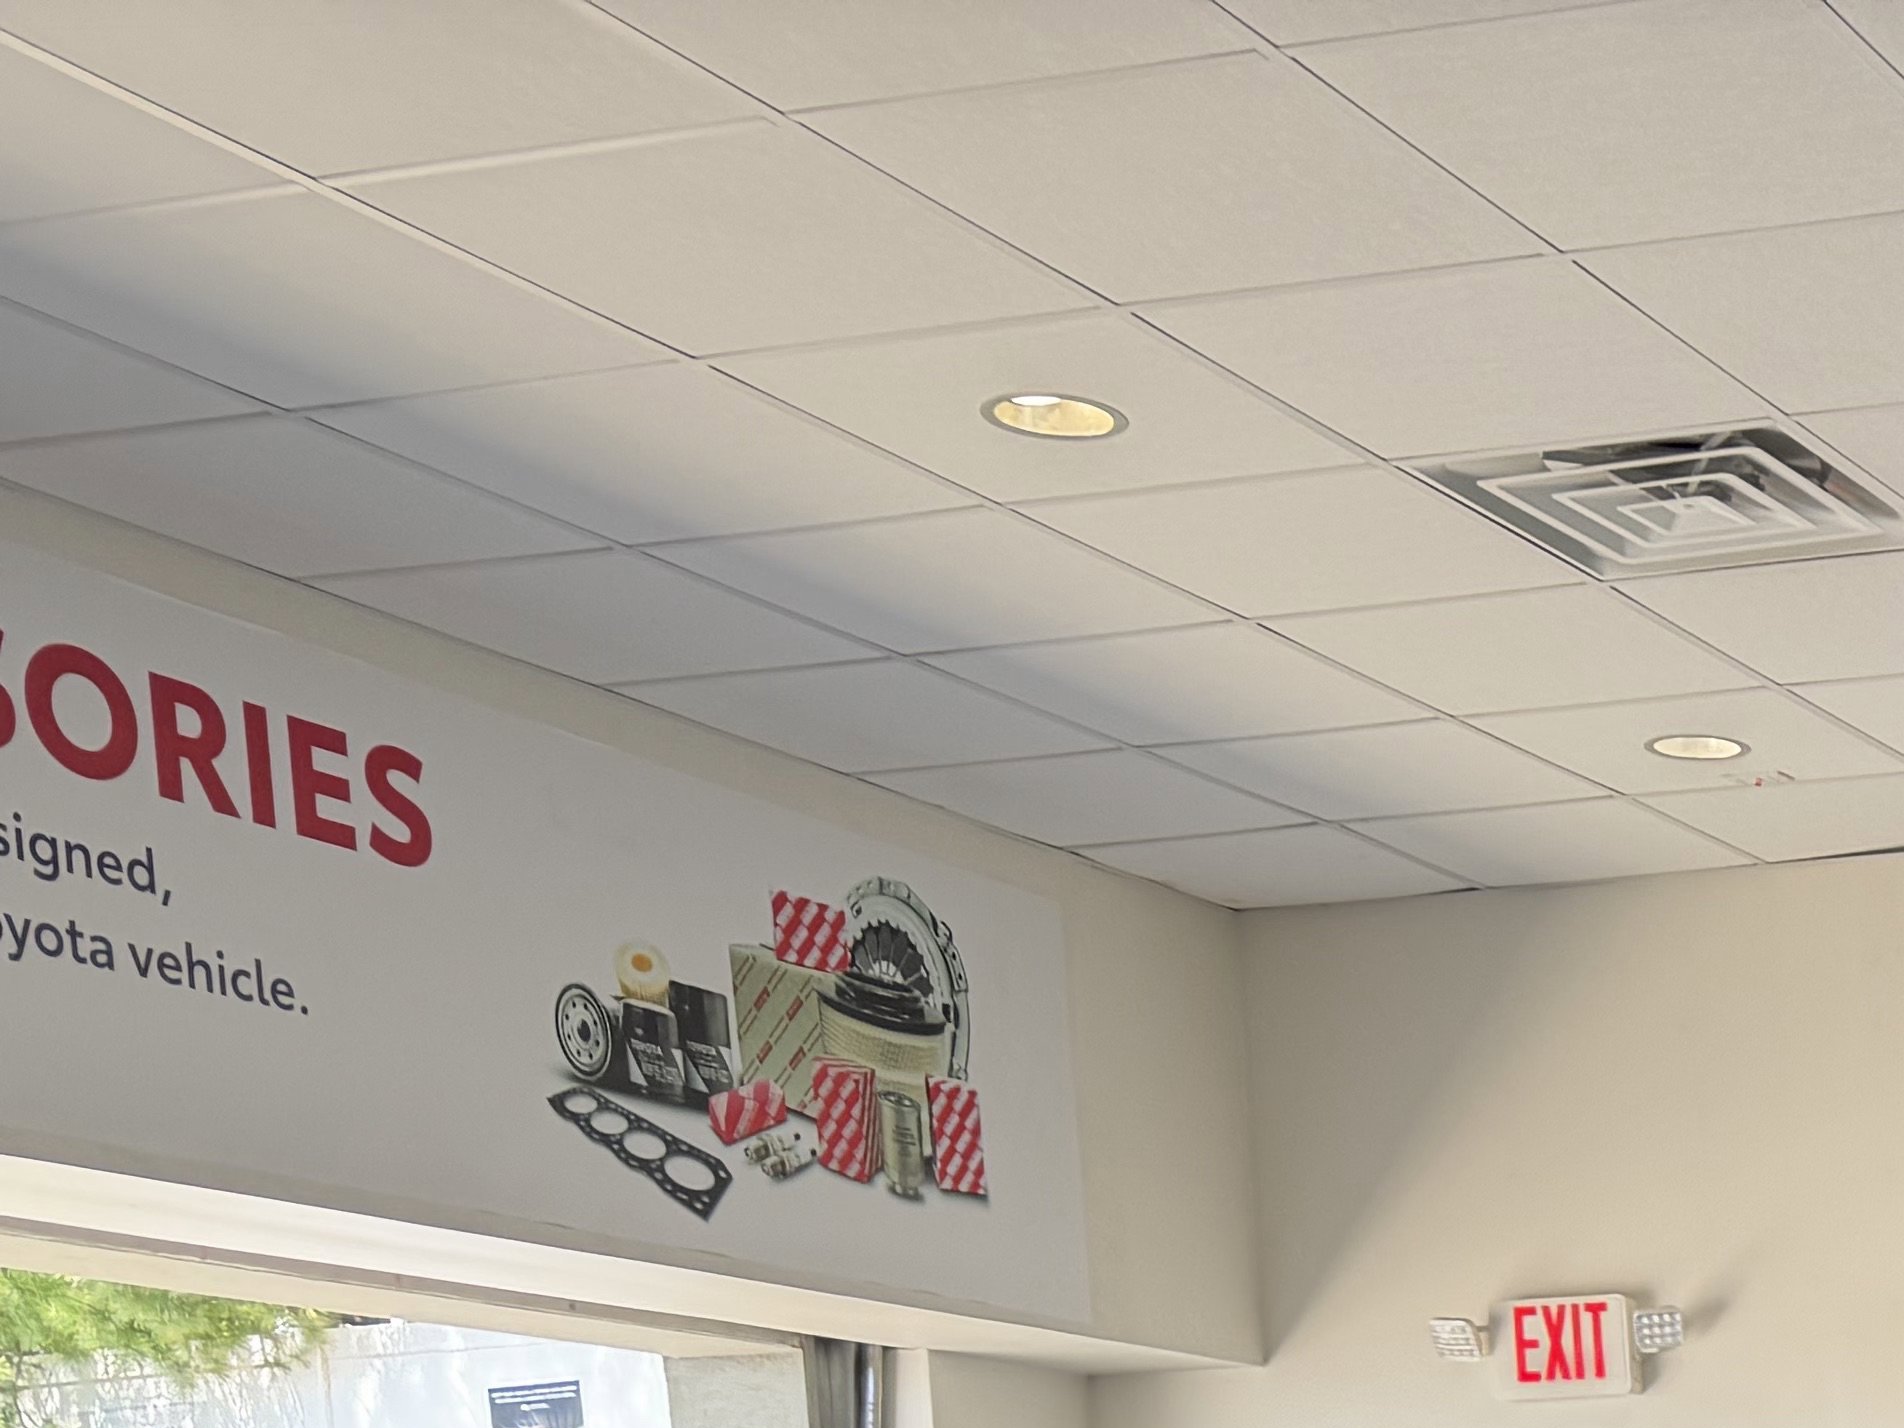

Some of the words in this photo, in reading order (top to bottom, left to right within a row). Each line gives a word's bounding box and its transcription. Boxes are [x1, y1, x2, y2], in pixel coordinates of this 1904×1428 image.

[0, 630, 433, 868] ORIES
[0, 911, 115, 971] yota
[127, 941, 309, 1015] vehicle.
[1513, 1302, 1608, 1382] EXIT
